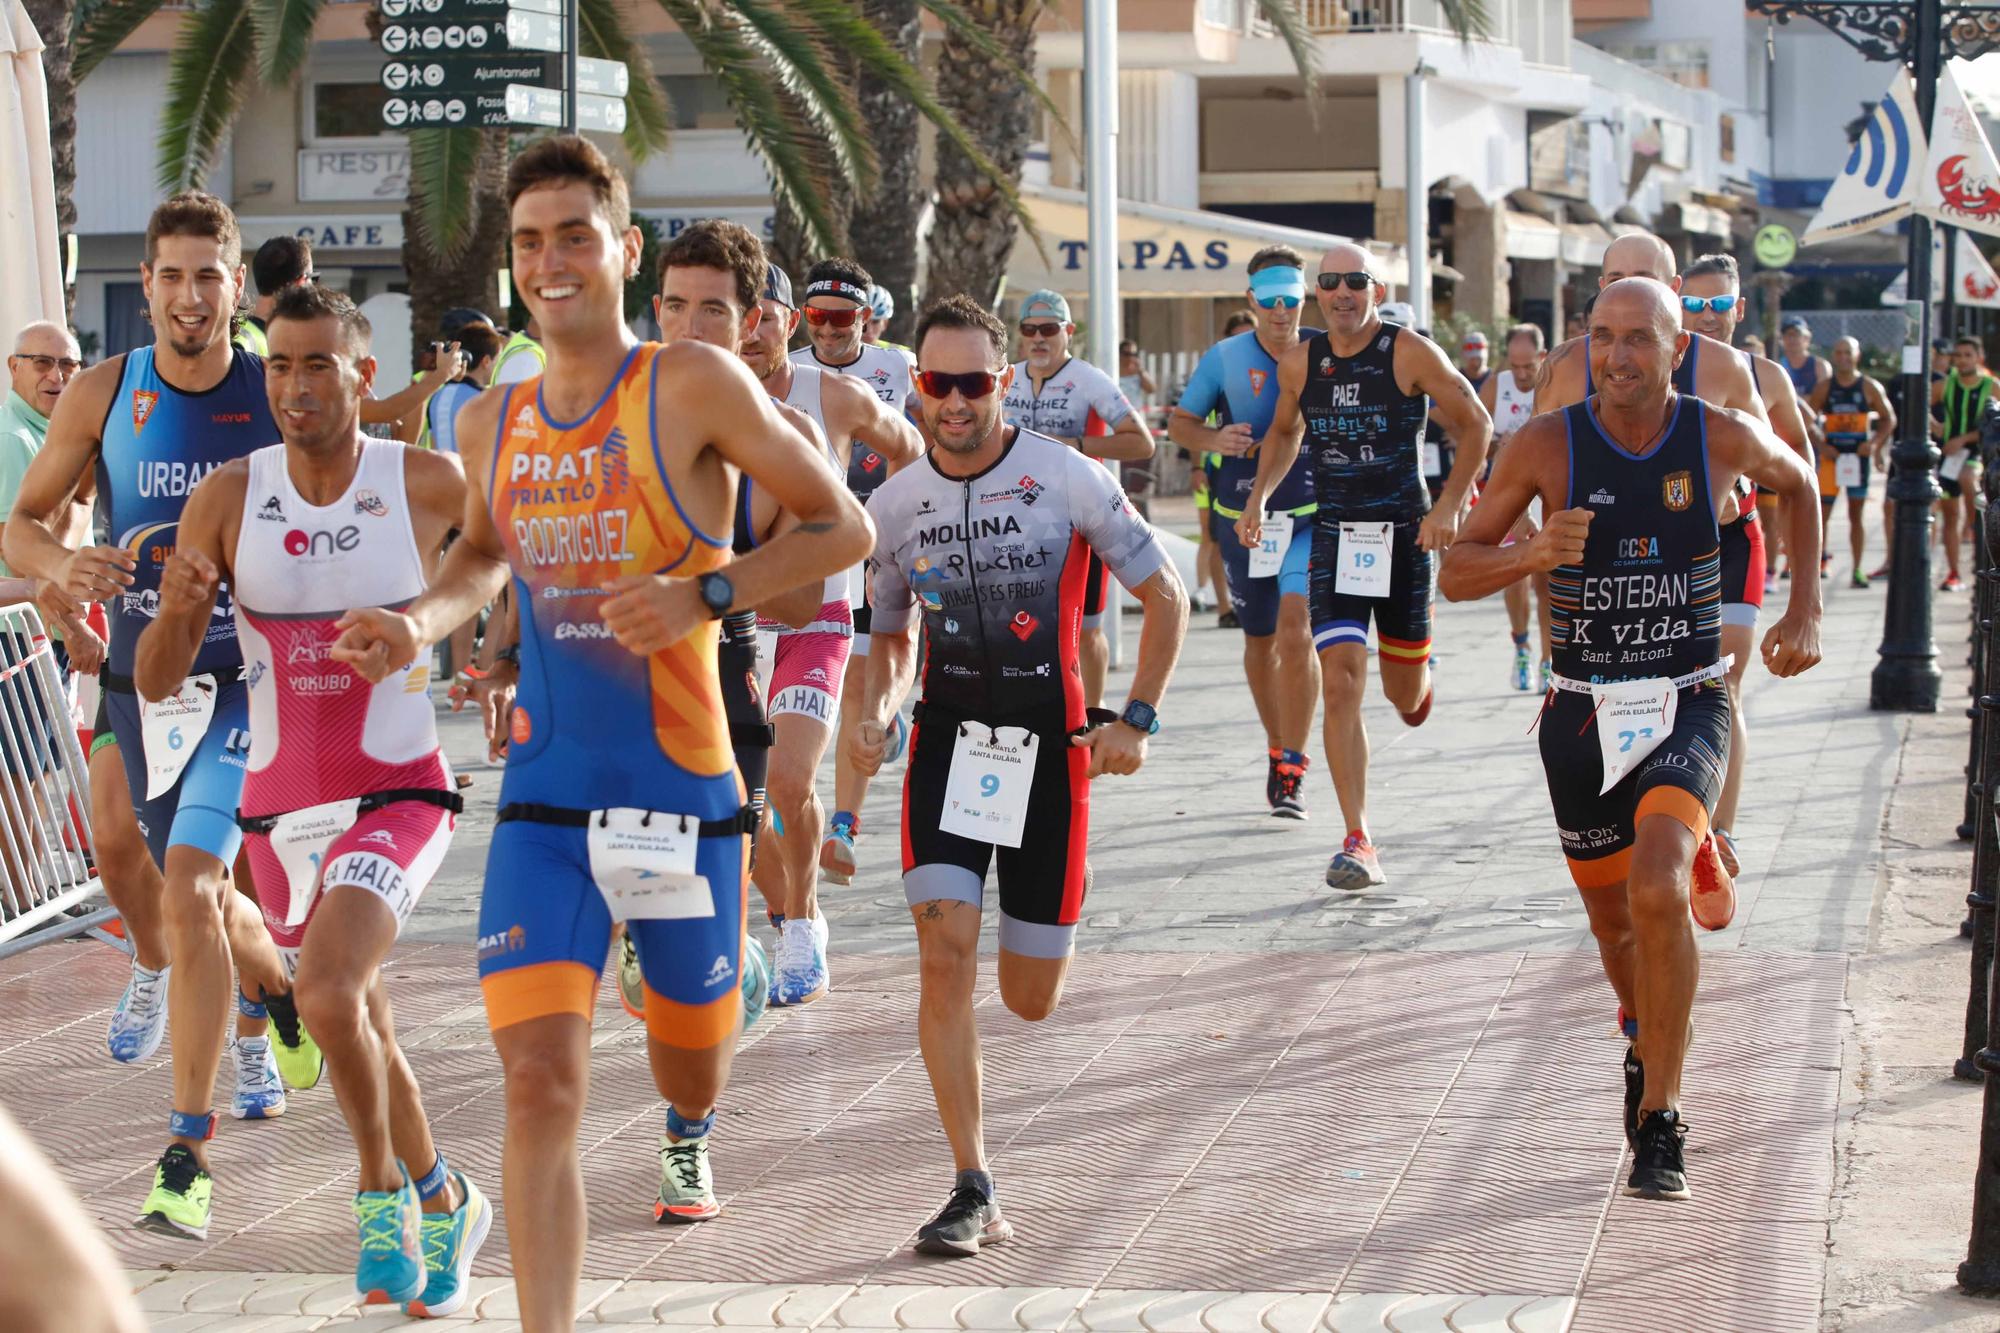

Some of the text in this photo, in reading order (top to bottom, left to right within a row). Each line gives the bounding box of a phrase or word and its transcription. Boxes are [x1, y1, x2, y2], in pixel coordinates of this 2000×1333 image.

[474, 66, 541, 81] Ajuntament
[297, 225, 384, 246] CAFE
[1059, 240, 1230, 270] TPAS
[1004, 394, 1068, 410] SÁNCHEZ
[1332, 383, 1360, 407] PAEZ
[511, 445, 599, 483] PRAT
[511, 479, 596, 506] TRIATLÓ
[514, 508, 635, 567] RODRIGUEZ
[919, 515, 1022, 549] MOLINA
[992, 542, 1026, 554] hotel
[1262, 540, 1278, 553] 21
[1618, 536, 1659, 558] CCSA
[947, 546, 1053, 578] Puchet
[1354, 552, 1376, 569] 19
[1640, 558, 1664, 566] ANTONI
[1008, 579, 1046, 598] FREUS
[1583, 573, 1687, 612] ESTEBAN
[1571, 615, 1691, 645] K vida
[1581, 643, 1673, 664] Sant Antoni
[288, 674, 350, 694] YOKUBO
[168, 726, 184, 750] 6
[985, 743, 1018, 754] AQUATLÓ
[968, 749, 1022, 764] SANTA EULÀRIA
[980, 774, 1000, 798] 9
[1590, 834, 1621, 848] IBIZA
[343, 857, 403, 896] HALF
